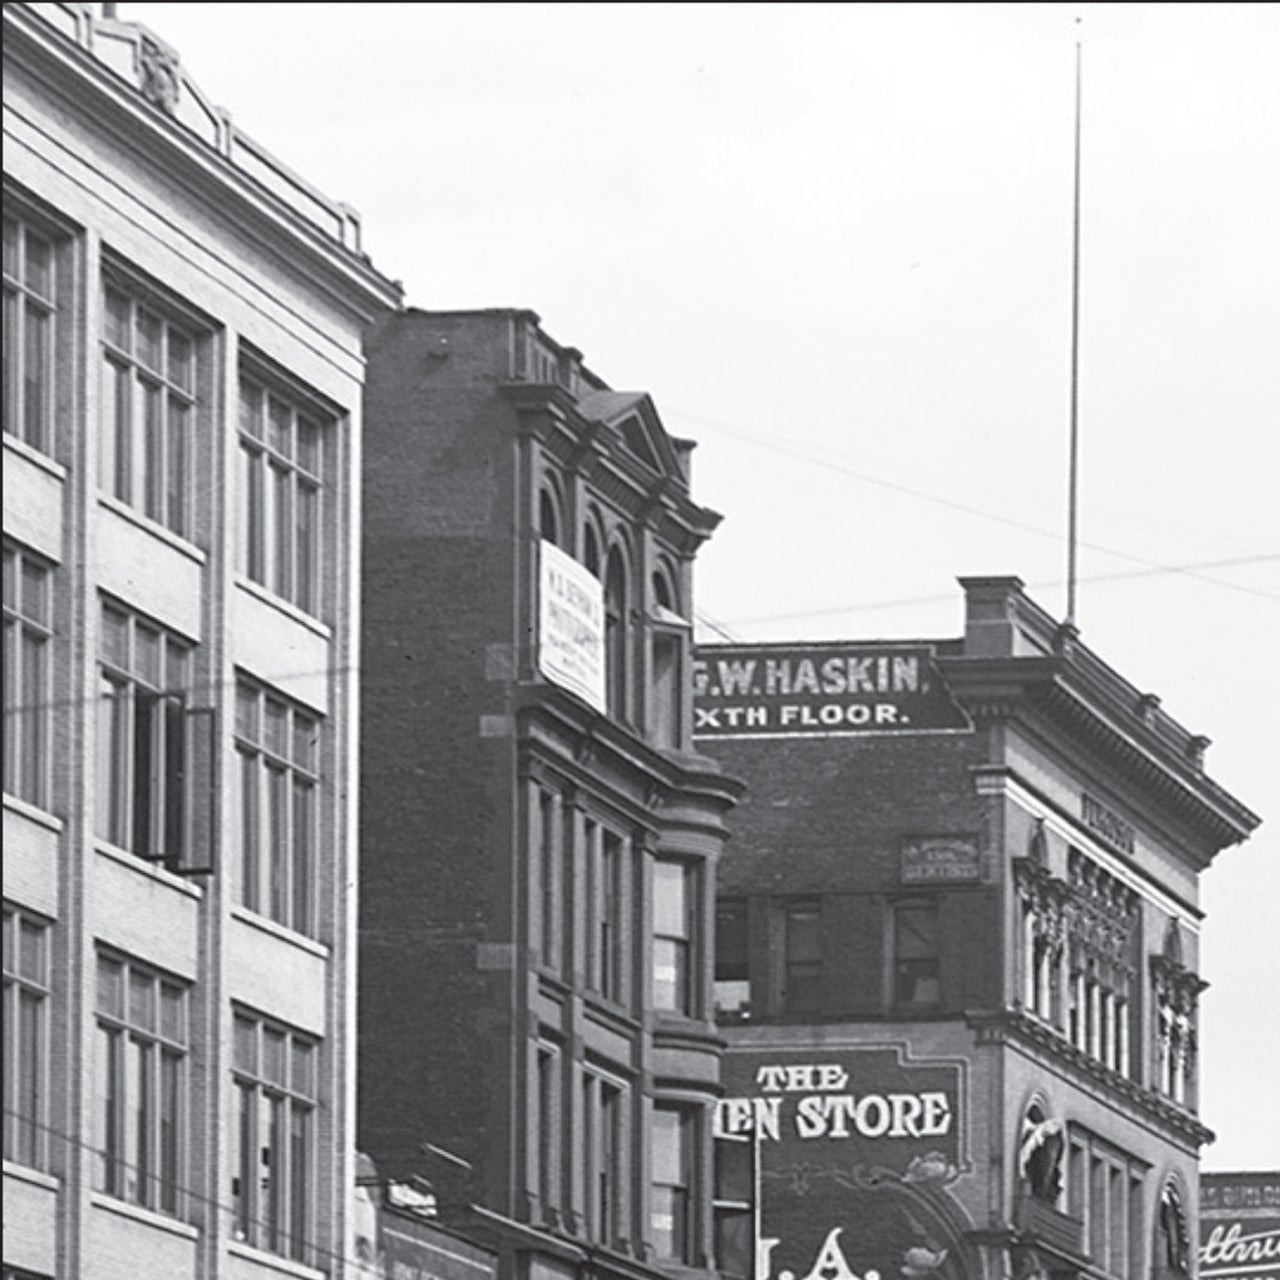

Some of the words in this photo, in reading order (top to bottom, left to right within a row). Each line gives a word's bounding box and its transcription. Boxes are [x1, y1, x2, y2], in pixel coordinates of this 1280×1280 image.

[780, 703, 910, 725] FLOOR.
[757, 1065, 848, 1091] THE
[796, 1093, 951, 1138] STORE
